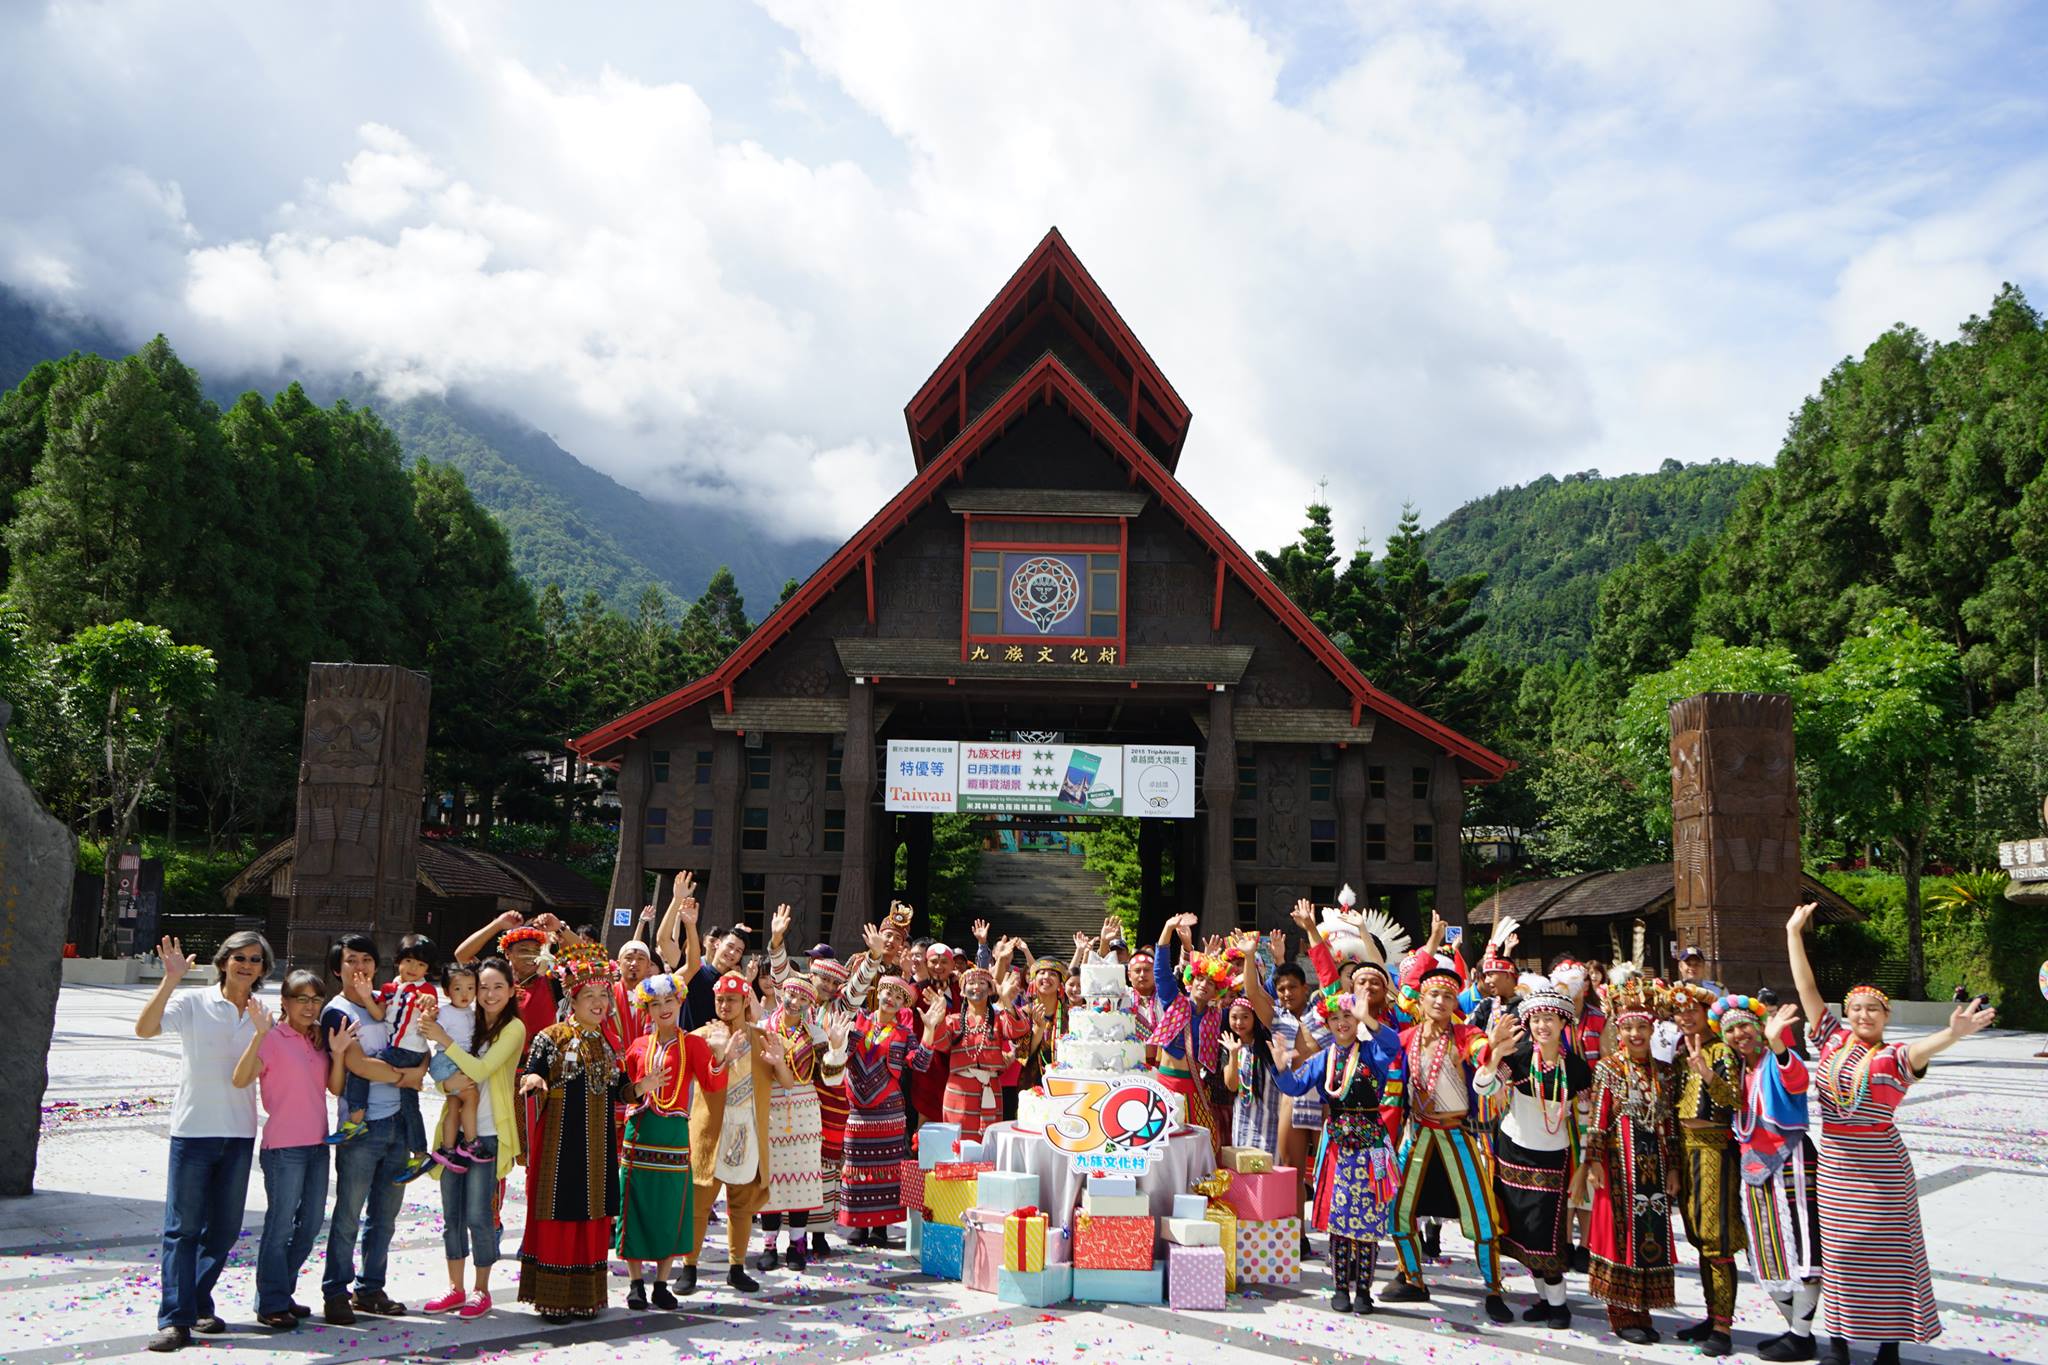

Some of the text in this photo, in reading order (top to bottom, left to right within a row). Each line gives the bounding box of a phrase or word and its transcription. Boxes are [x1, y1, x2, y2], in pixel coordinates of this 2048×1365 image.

[970, 646, 1118, 665] 九族文化村
[967, 748, 1022, 760] 九族文化村
[900, 760, 945, 777] 特優等
[967, 764, 1022, 775] 日月潭纜車
[967, 779, 1022, 791] 纜車賞湖景
[889, 786, 953, 802] Taiwan
[1046, 1077, 1168, 1152] 30
[1076, 1154, 1145, 1169] 九族文化村
